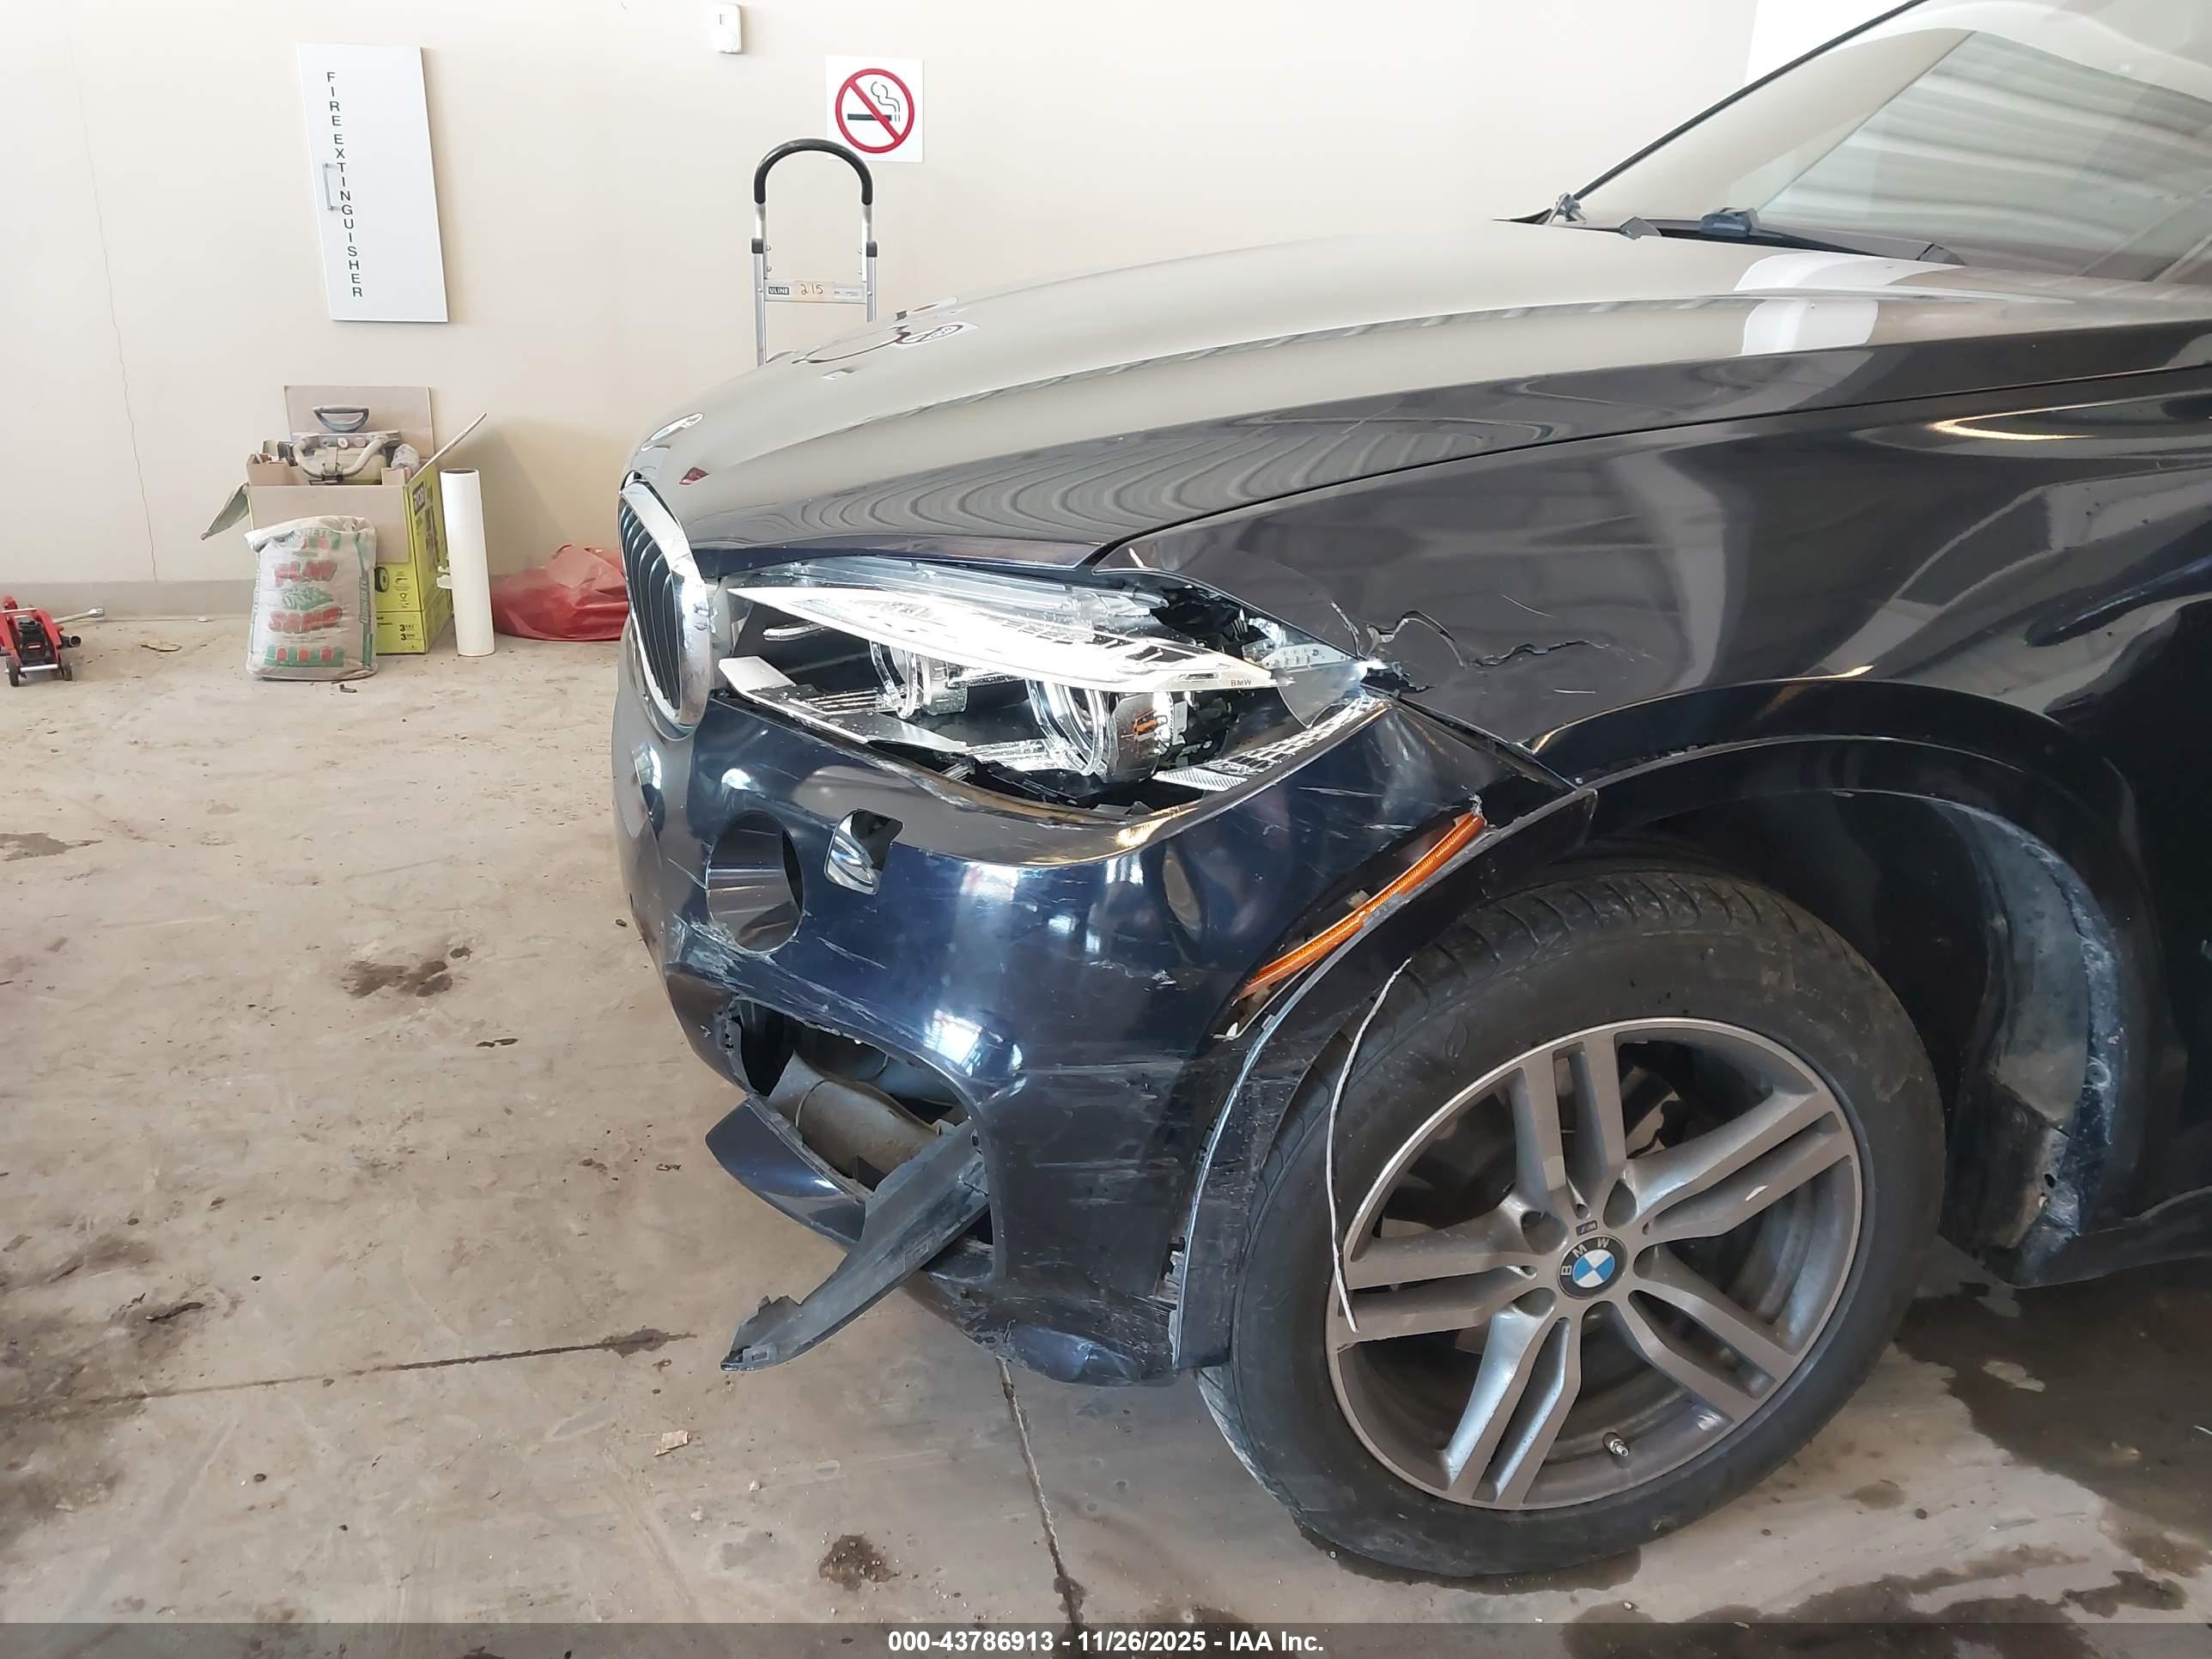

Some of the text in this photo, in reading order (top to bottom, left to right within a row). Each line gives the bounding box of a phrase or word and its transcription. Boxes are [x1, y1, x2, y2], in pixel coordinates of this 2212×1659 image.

[326, 71, 363, 298] FIRE EXTINGUISHER
[769, 287, 789, 295] ULINE
[1559, 1237, 1611, 1276] BMW
